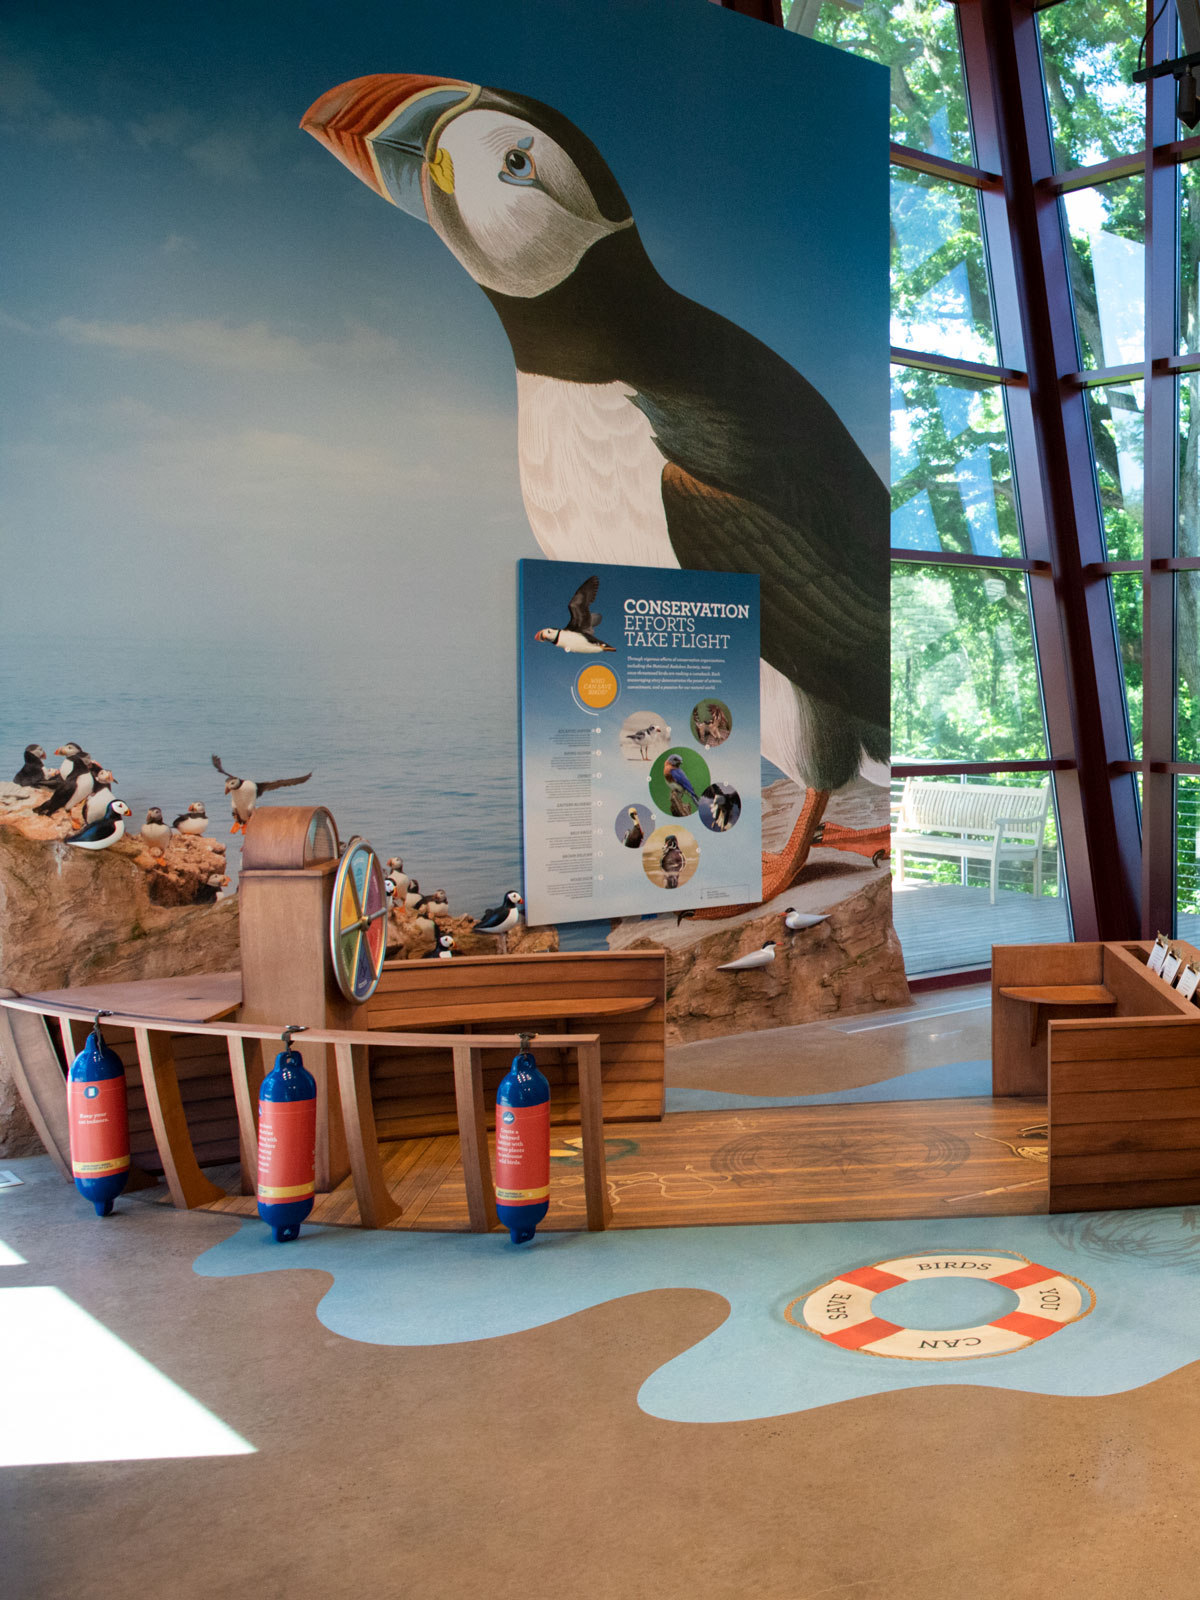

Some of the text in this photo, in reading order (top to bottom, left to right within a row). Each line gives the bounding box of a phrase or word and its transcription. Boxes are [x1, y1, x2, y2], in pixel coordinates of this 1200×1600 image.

[623, 598, 750, 619] CONSERVATION
[624, 615, 696, 633] EFFORTS
[624, 631, 731, 649] TAKE FLIGHT
[827, 1260, 1061, 1349] BIRDS YOU CAN SAVE
